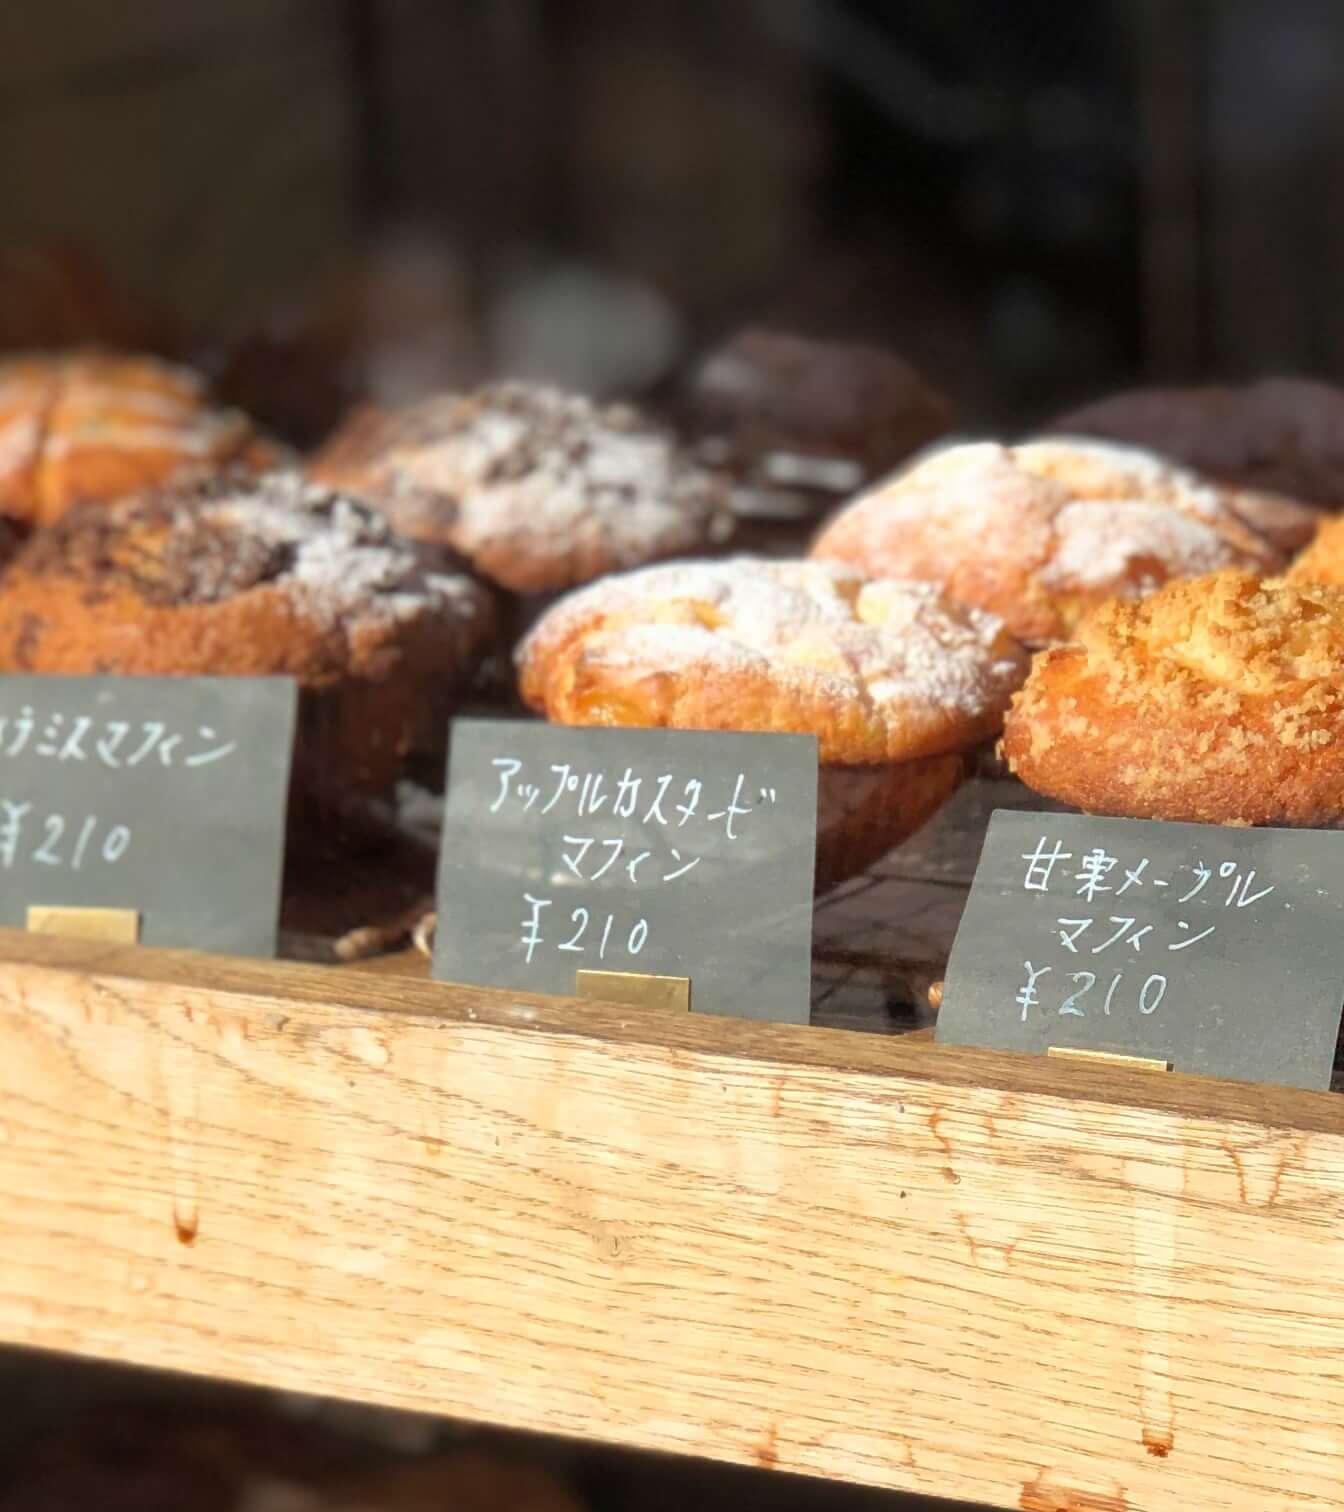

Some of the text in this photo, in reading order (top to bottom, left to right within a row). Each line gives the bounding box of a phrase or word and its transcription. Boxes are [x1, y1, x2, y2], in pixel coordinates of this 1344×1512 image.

[490, 758, 777, 840] アップルカスタード
[562, 835, 701, 883] マフィン
[1022, 836, 1274, 907] 甘栗メープル
[521, 893, 649, 964] ¥210
[1056, 917, 1216, 954] マフィン
[1015, 960, 1167, 1022] ¥210
